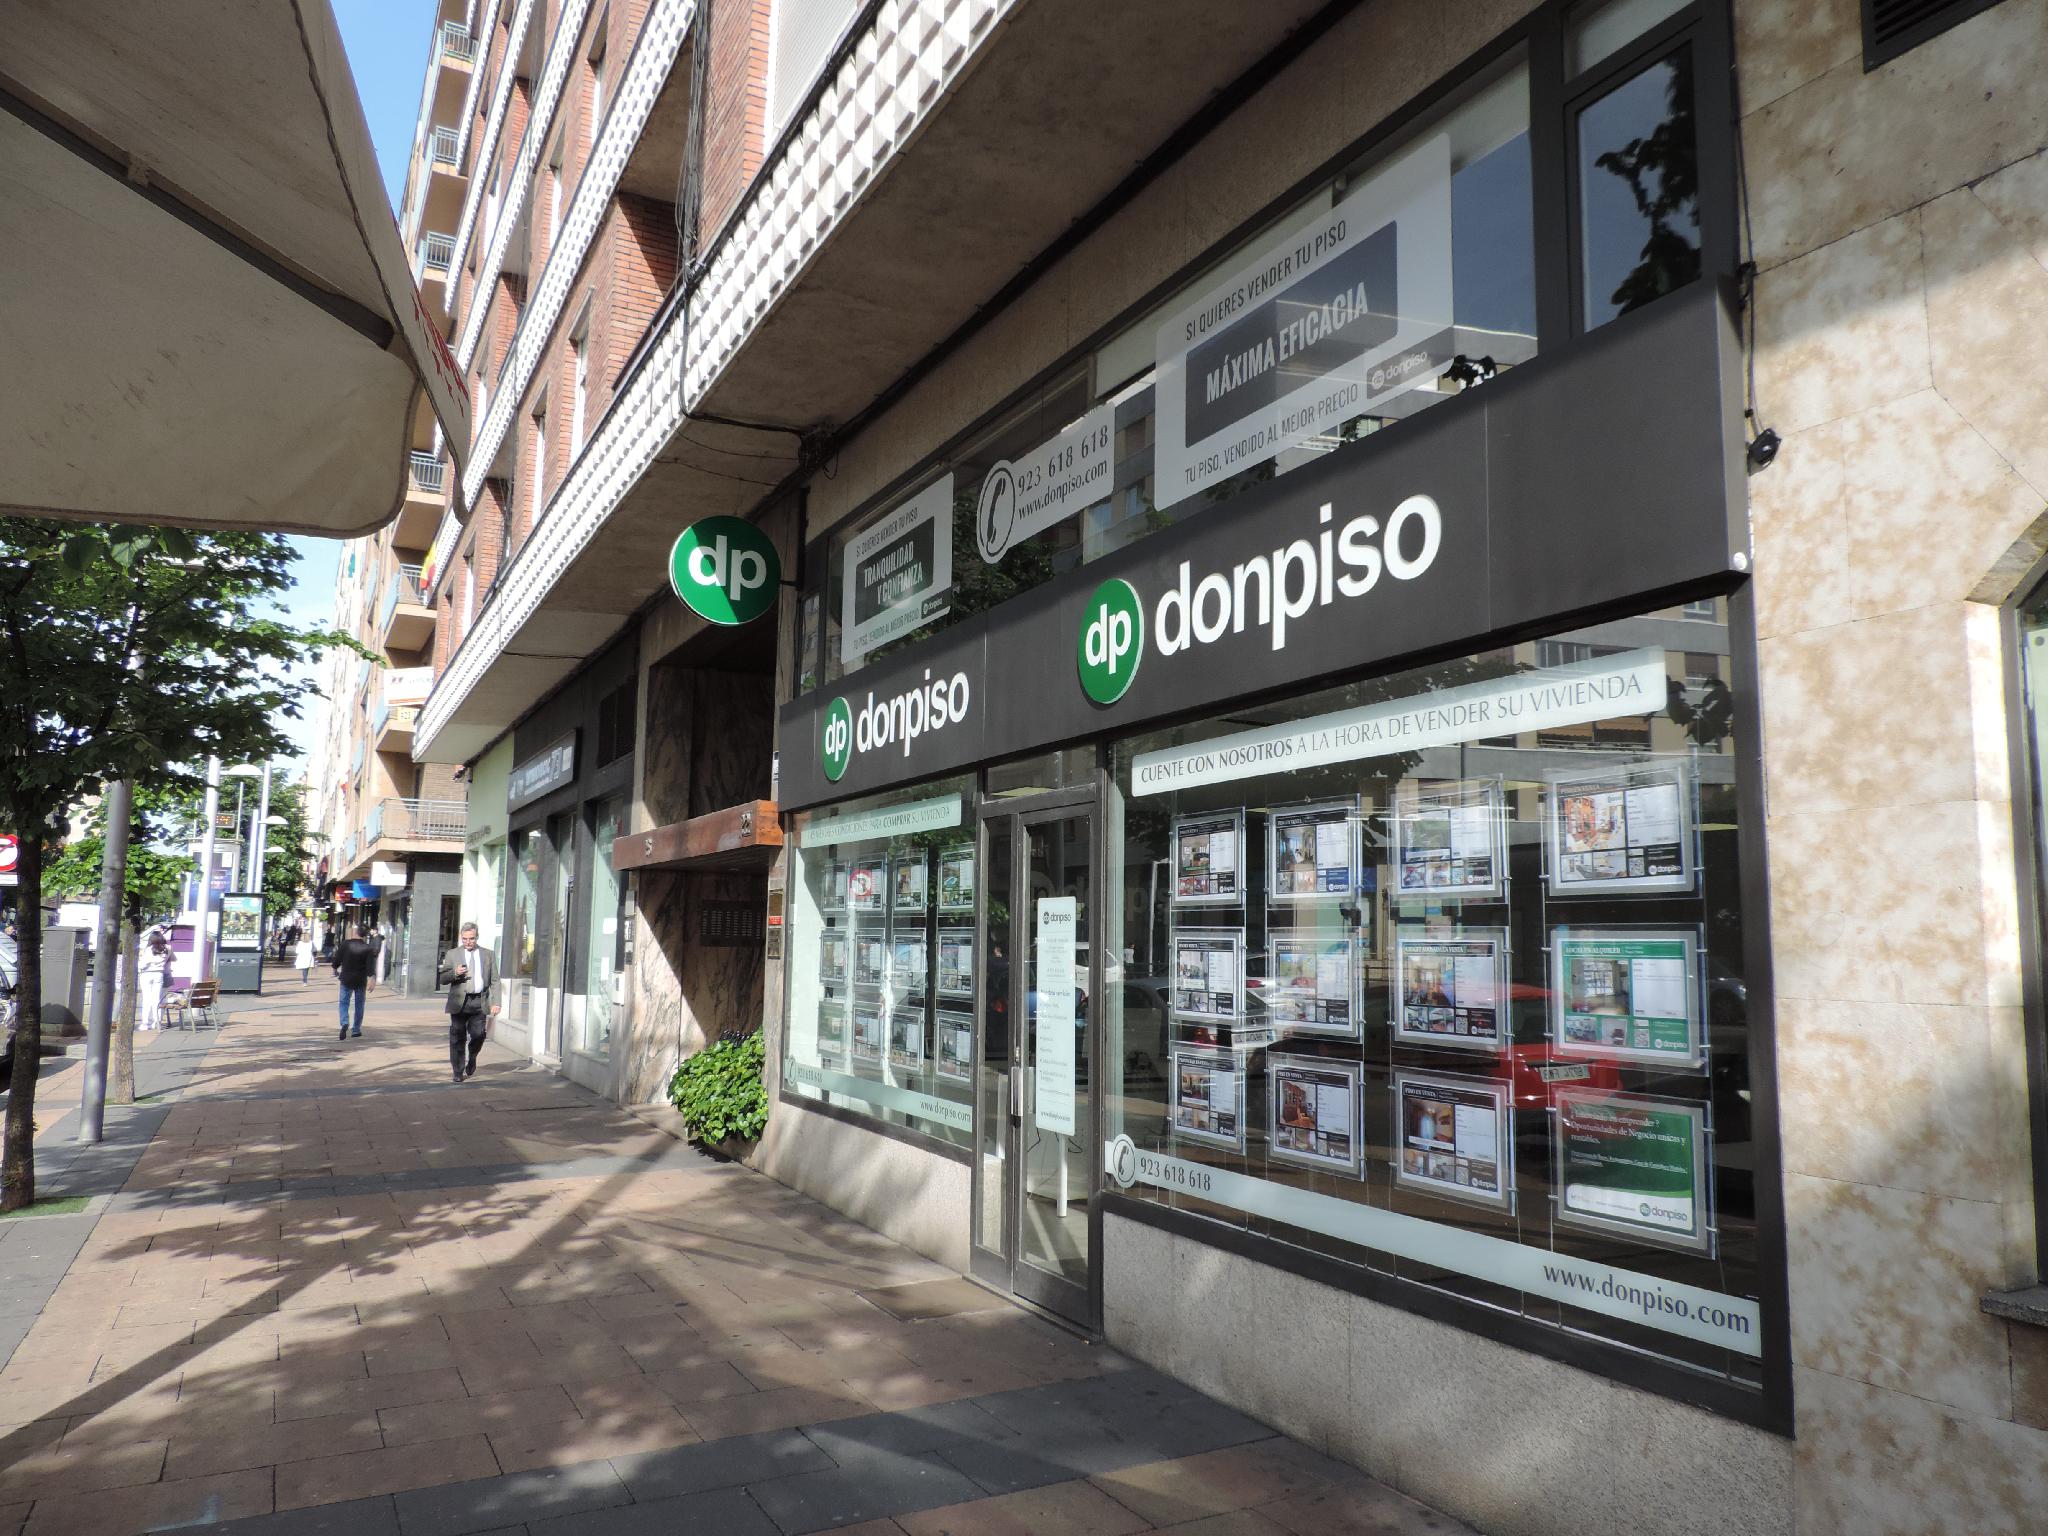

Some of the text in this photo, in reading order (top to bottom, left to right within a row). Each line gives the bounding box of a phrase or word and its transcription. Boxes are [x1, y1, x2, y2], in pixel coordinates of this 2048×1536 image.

[1186, 219, 1347, 342] SI QUIERES VENDER TU PISO
[1206, 281, 1369, 405] MÁXIMA EFICACIA
[1386, 352, 1428, 381] donpiso
[1018, 425, 1108, 496] 923 618 618
[1185, 384, 1358, 485] TU PISO, VENDIDO AL MEJOR PRECIO
[1018, 460, 1108, 520] www.donpiso.com
[688, 534, 767, 601] dp
[864, 540, 914, 588] TRANQUILIDAD
[877, 561, 923, 605] Y CONFIANZA
[1154, 494, 1442, 651] donpiso
[1085, 603, 1132, 675] dp
[825, 713, 847, 762] dp
[857, 668, 970, 758] donpiso
[1141, 672, 1642, 783] CUENTE CON NOSOTROS A LA HORA DE VENDER SU VIVIENDA
[883, 813, 911, 829] COMPRAR
[920, 805, 950, 823] VIVIENDA
[221, 932, 259, 941] SALAMANCA
[1051, 912, 1071, 924] donpiso
[1571, 1121, 1618, 1135] Oportunidades
[1619, 1126, 1627, 1135] de
[1629, 1128, 1657, 1140] Negocio
[1618, 1117, 1655, 1127] emprender
[1140, 1157, 1211, 1191] 923 618 618
[1651, 1206, 1687, 1222] donpiso
[1543, 1265, 1750, 1334] www.donpiso.com
